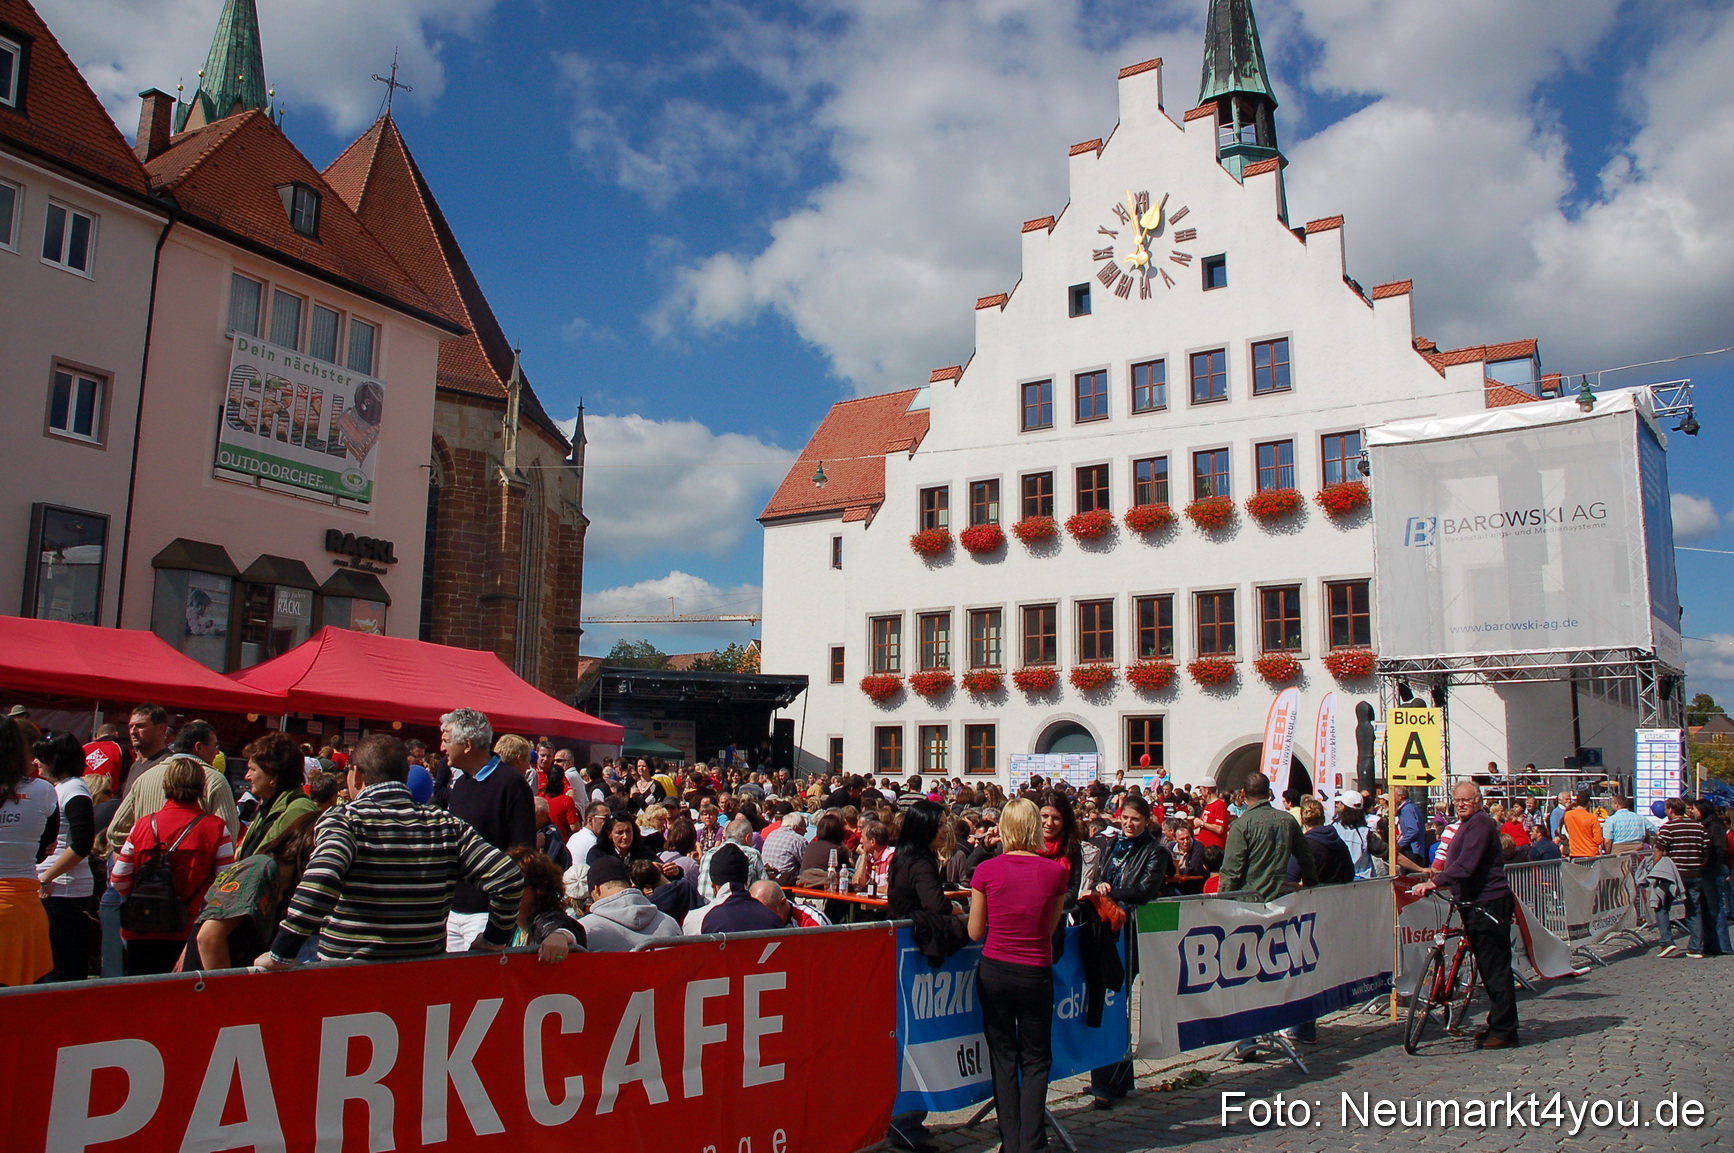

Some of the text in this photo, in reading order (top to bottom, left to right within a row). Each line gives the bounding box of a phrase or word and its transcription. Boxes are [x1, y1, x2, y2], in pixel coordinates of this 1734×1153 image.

[237, 337, 352, 387] Dein nächster
[225, 364, 348, 459] GRILL
[1443, 502, 1607, 535] BAROWSKI AG
[1515, 527, 1531, 536] und
[1534, 522, 1607, 535] Mediensysteme
[325, 528, 398, 565] RACKL
[277, 598, 302, 616] RACKL
[1450, 617, 1579, 634] www.barowski-ag.de
[1394, 711, 1436, 726] Block
[1270, 702, 1289, 783] KLEBL
[1399, 731, 1430, 769] A
[1178, 913, 1320, 995] BOCK
[912, 959, 979, 1020] maxi
[45, 942, 787, 1153] PARKCAFÉ
[957, 1041, 982, 1078] dsl
